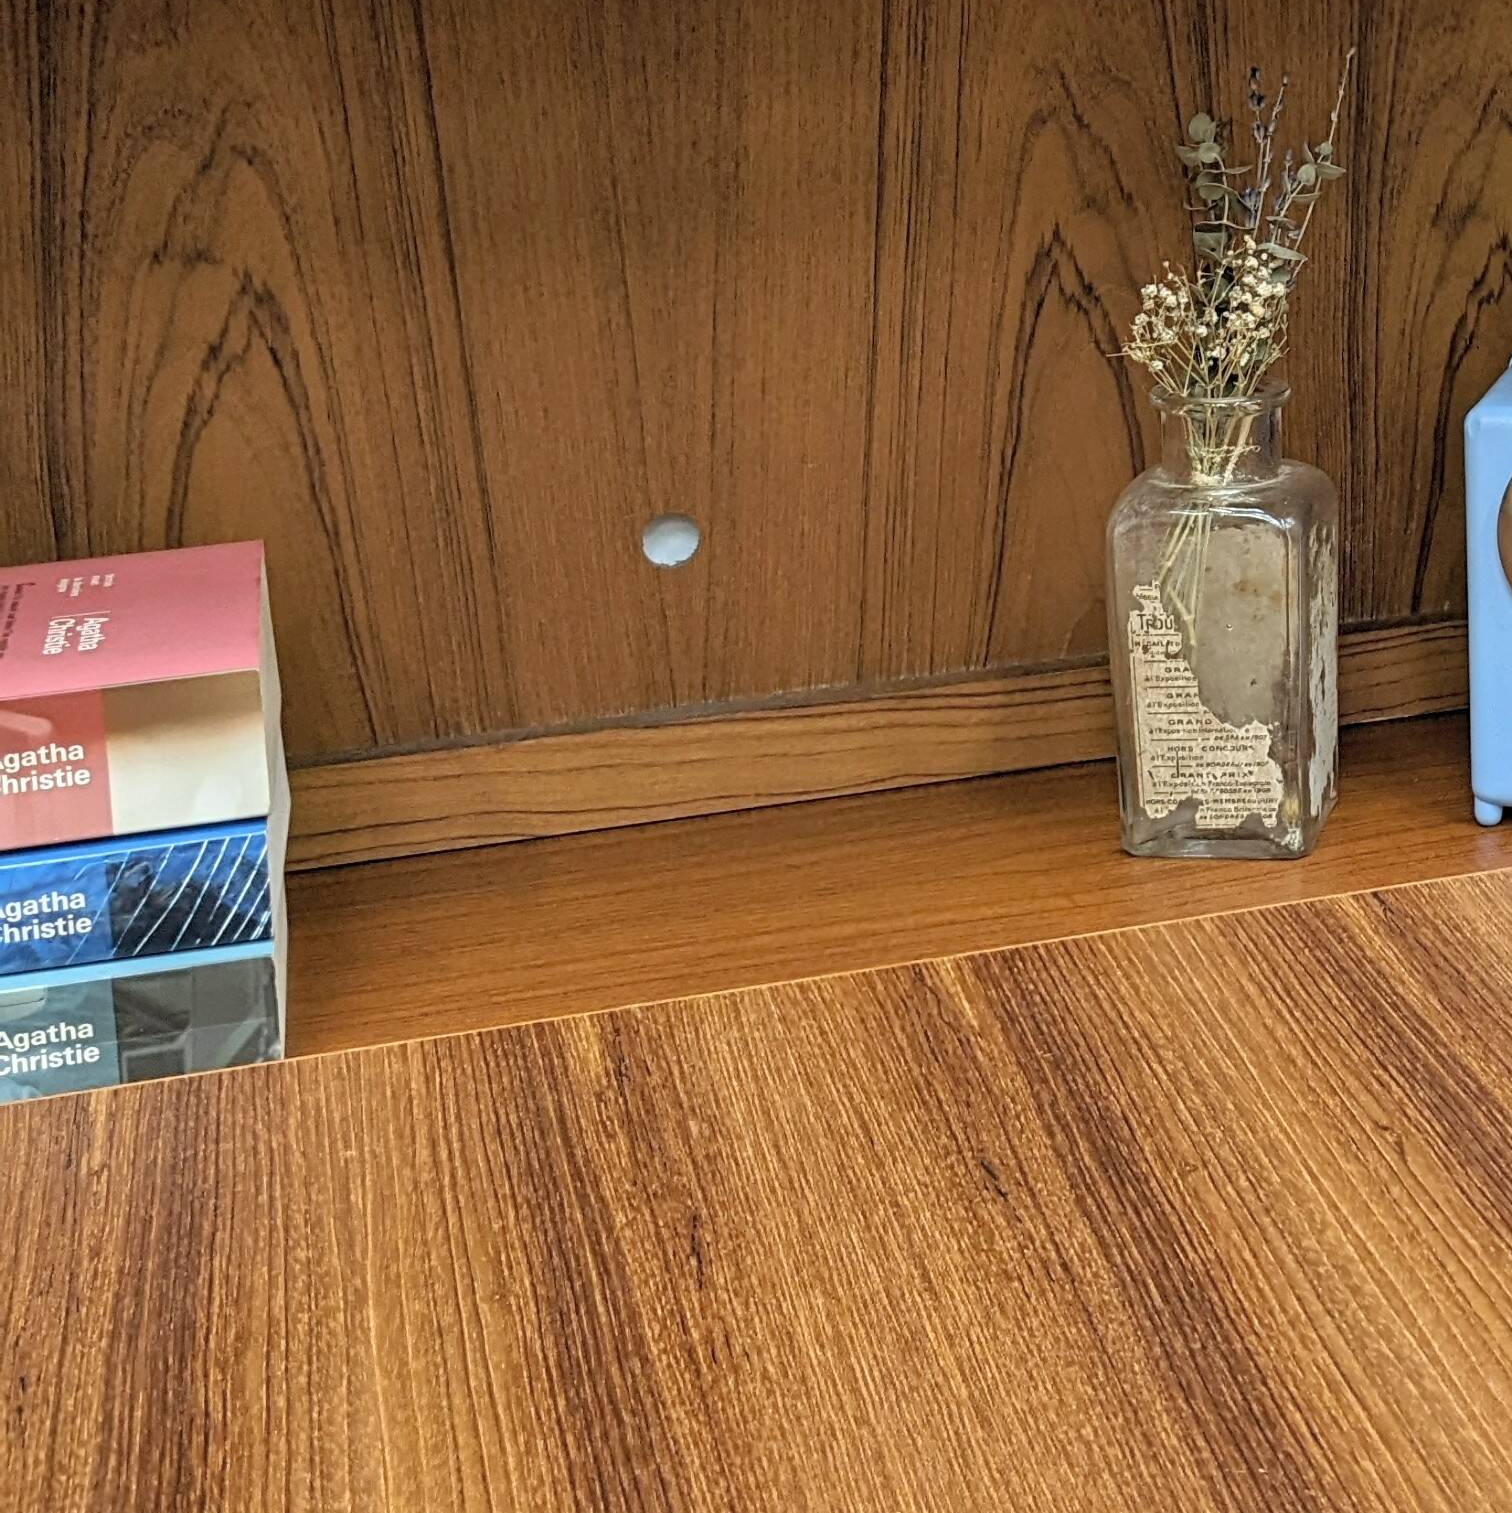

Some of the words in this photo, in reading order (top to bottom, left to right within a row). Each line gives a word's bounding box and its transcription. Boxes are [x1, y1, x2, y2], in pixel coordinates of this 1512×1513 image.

[42, 618, 76, 655] Christie
[76, 617, 110, 651] Agatha
[0, 743, 84, 773] gatha
[0, 765, 91, 795] hristie
[0, 891, 86, 922] gatha
[0, 914, 93, 944] hristie
